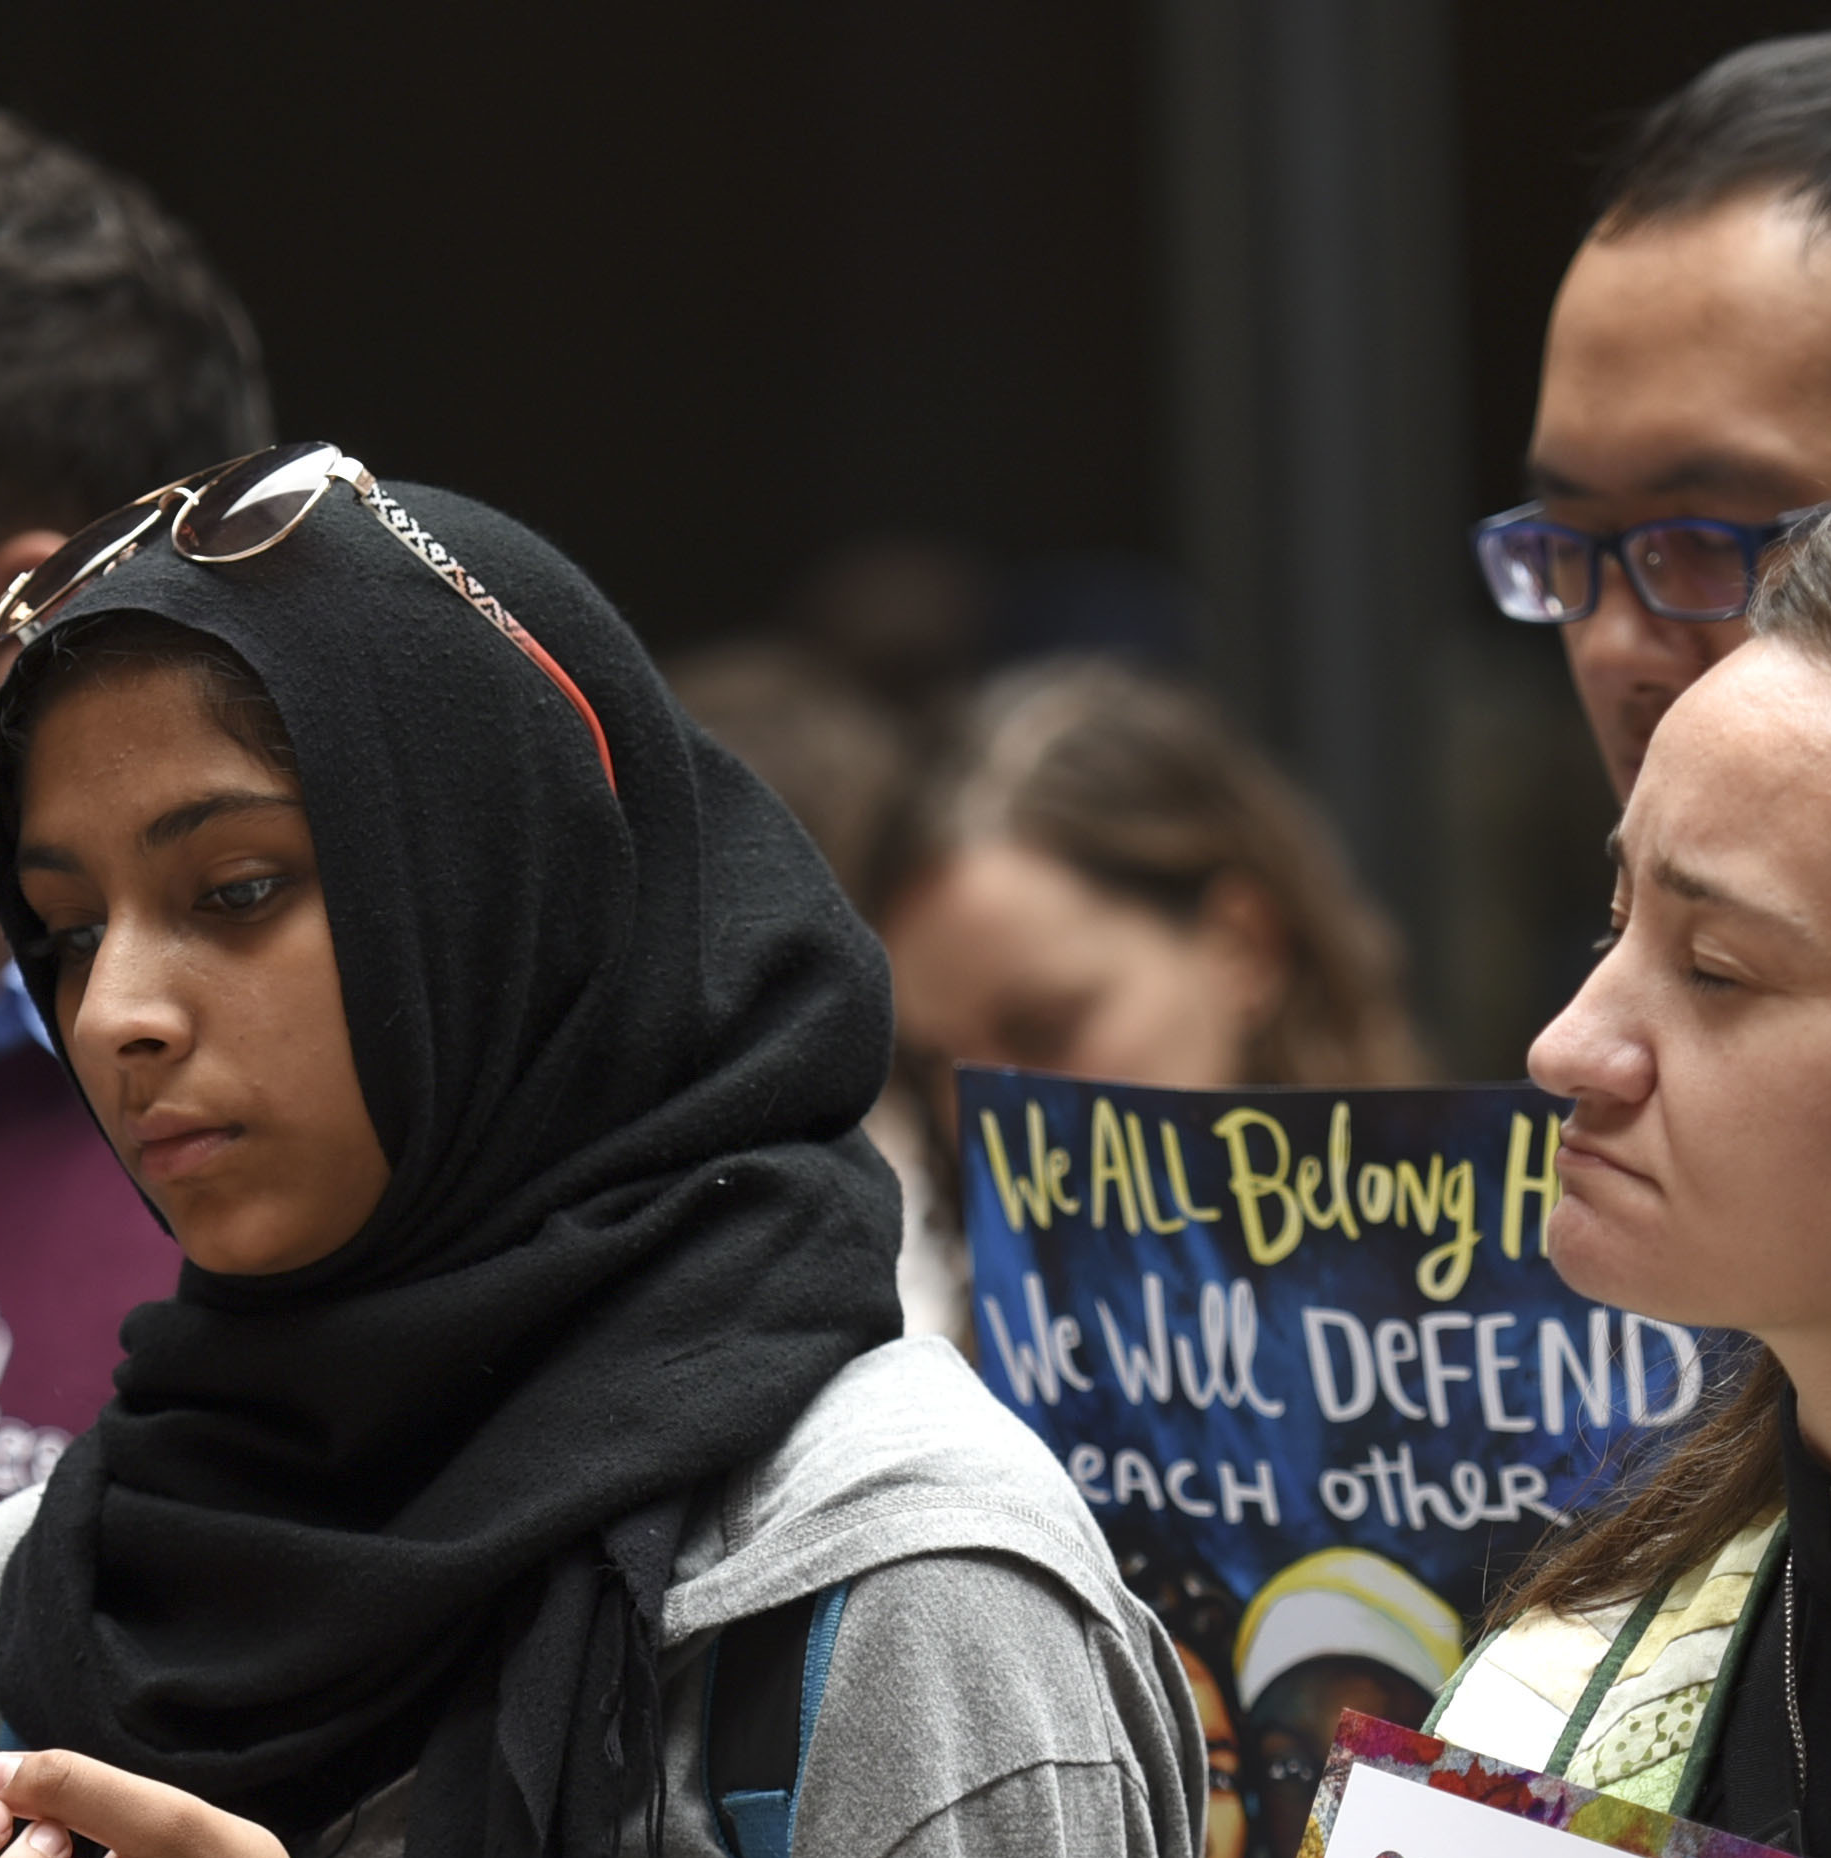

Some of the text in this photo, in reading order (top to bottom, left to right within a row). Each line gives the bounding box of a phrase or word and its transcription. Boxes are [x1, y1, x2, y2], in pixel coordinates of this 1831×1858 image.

[980, 1100, 1079, 1234] We
[1089, 1096, 1220, 1236] ALL
[983, 1274, 1094, 1407] We
[1094, 1271, 1287, 1420] Will
